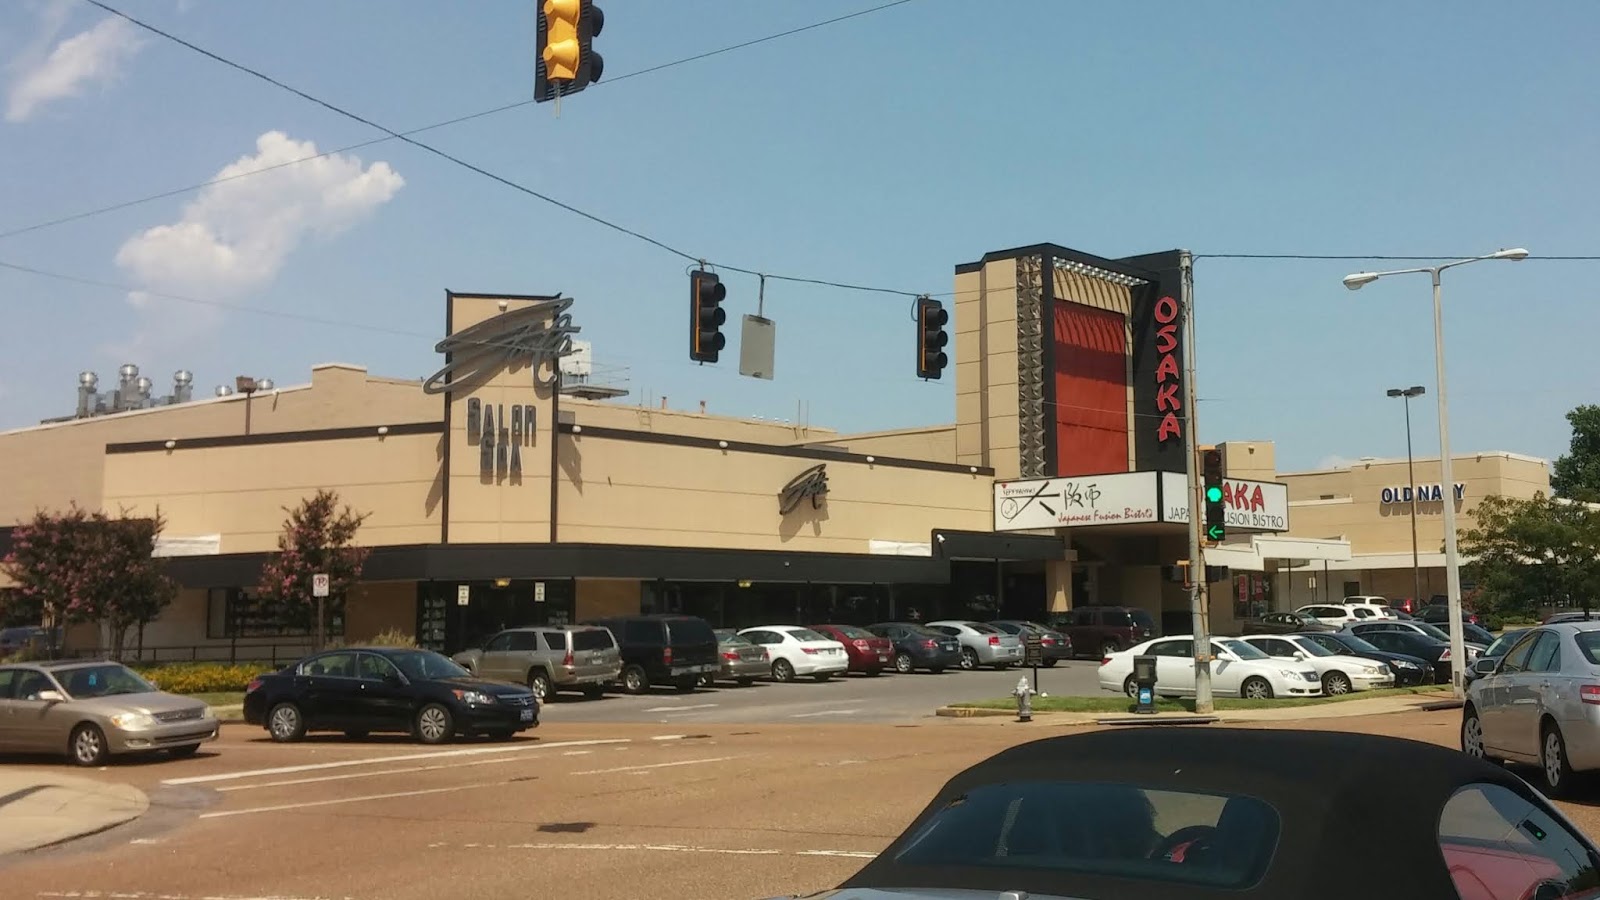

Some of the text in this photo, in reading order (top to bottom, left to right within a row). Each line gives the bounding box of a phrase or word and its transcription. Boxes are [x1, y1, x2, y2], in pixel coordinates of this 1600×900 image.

[1154, 296, 1181, 442] OSAKA
[466, 397, 537, 436] SALON
[1200, 481, 1265, 513] AKA
[1381, 483, 1465, 504] OLD NAY
[1058, 512, 1091, 525] Japanese
[1093, 509, 1122, 522] Fusion
[1223, 511, 1251, 526] USION
[1252, 513, 1284, 528] BISTRO
